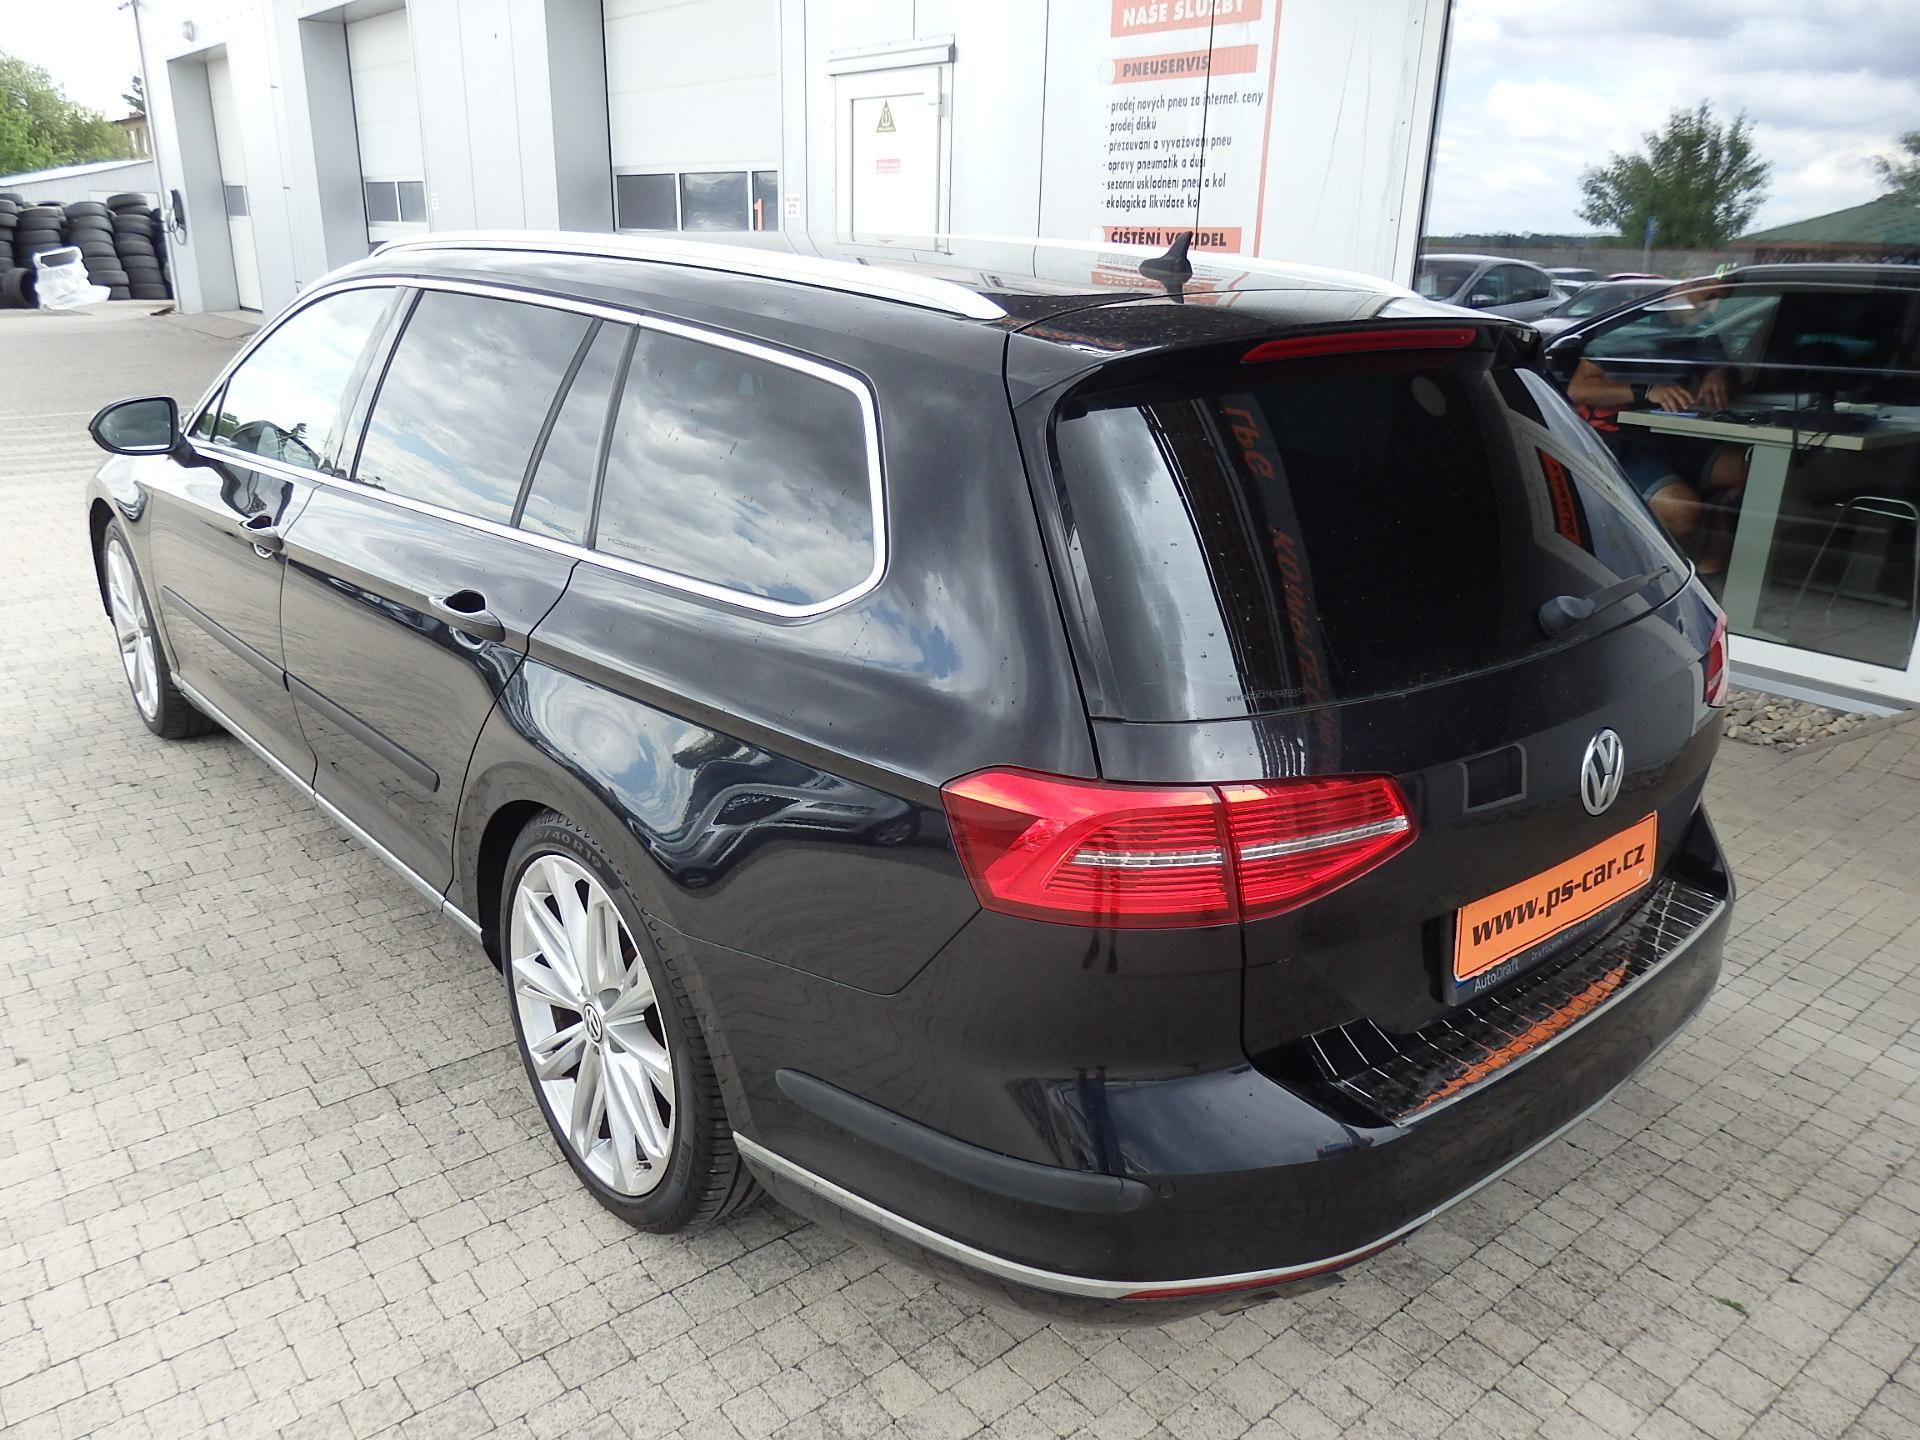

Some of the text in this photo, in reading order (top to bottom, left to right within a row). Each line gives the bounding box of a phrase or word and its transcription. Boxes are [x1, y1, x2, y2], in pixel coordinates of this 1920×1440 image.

[1123, 55, 1210, 77] PNEUSERVIS
[1111, 96, 1135, 115] prodej
[1167, 96, 1188, 111] pneu
[1190, 96, 1200, 106] za
[1242, 92, 1264, 106] ceny
[1110, 117, 1134, 135] prodej
[1153, 140, 1158, 150] a
[1211, 136, 1232, 150] pneu
[1108, 160, 1134, 174] opravy
[1137, 154, 1178, 173] pneumatik
[1182, 158, 1187, 169] a
[1182, 179, 1201, 191] pneu
[1205, 178, 1210, 188] a
[1213, 172, 1226, 188] kol
[1149, 194, 1185, 209] likvidace
[754, 199, 763, 231] 1
[1111, 227, 1160, 245] ČIŠTĚNÍ
[1472, 843, 1645, 946] www.ps-car.cz
[1474, 958, 1519, 993] AutoDraft
